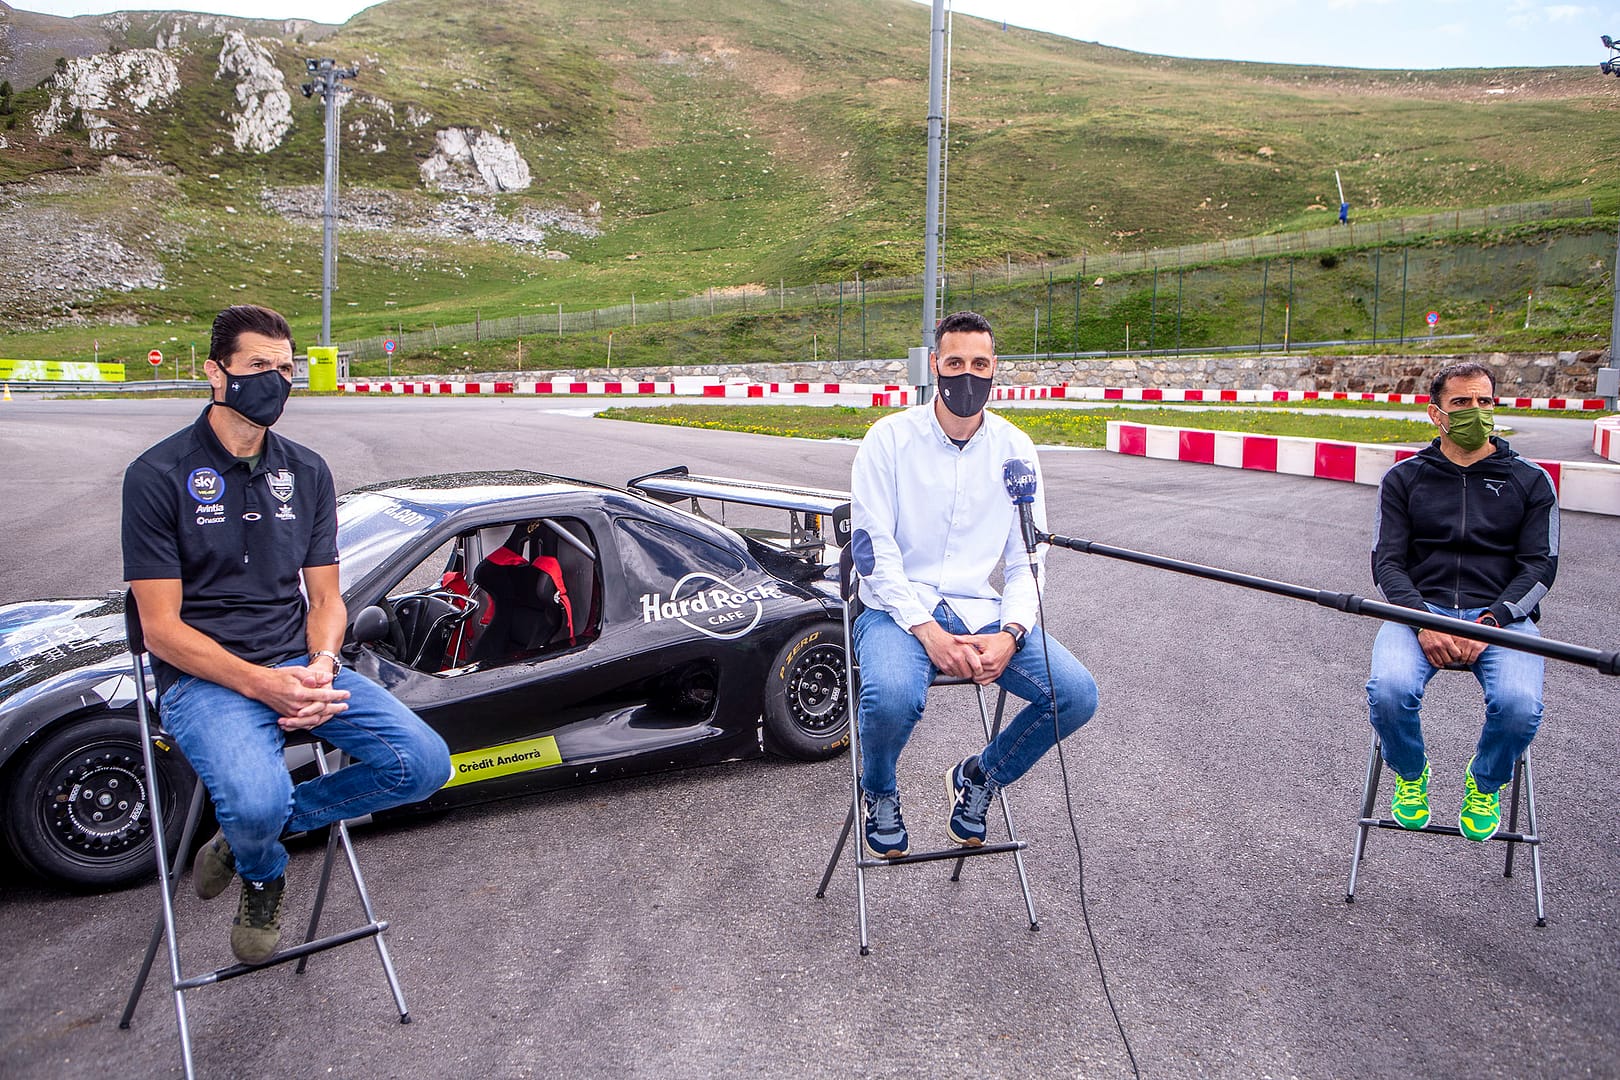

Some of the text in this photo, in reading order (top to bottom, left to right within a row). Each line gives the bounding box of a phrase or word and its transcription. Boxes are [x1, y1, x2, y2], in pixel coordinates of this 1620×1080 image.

[194, 475, 217, 489] sky
[195, 503, 224, 513] Avintia
[639, 584, 783, 623] Hard Rock
[708, 610, 745, 625] CAFE
[785, 632, 819, 666] ZERO
[459, 748, 541, 774] Crèdit Andorrà
